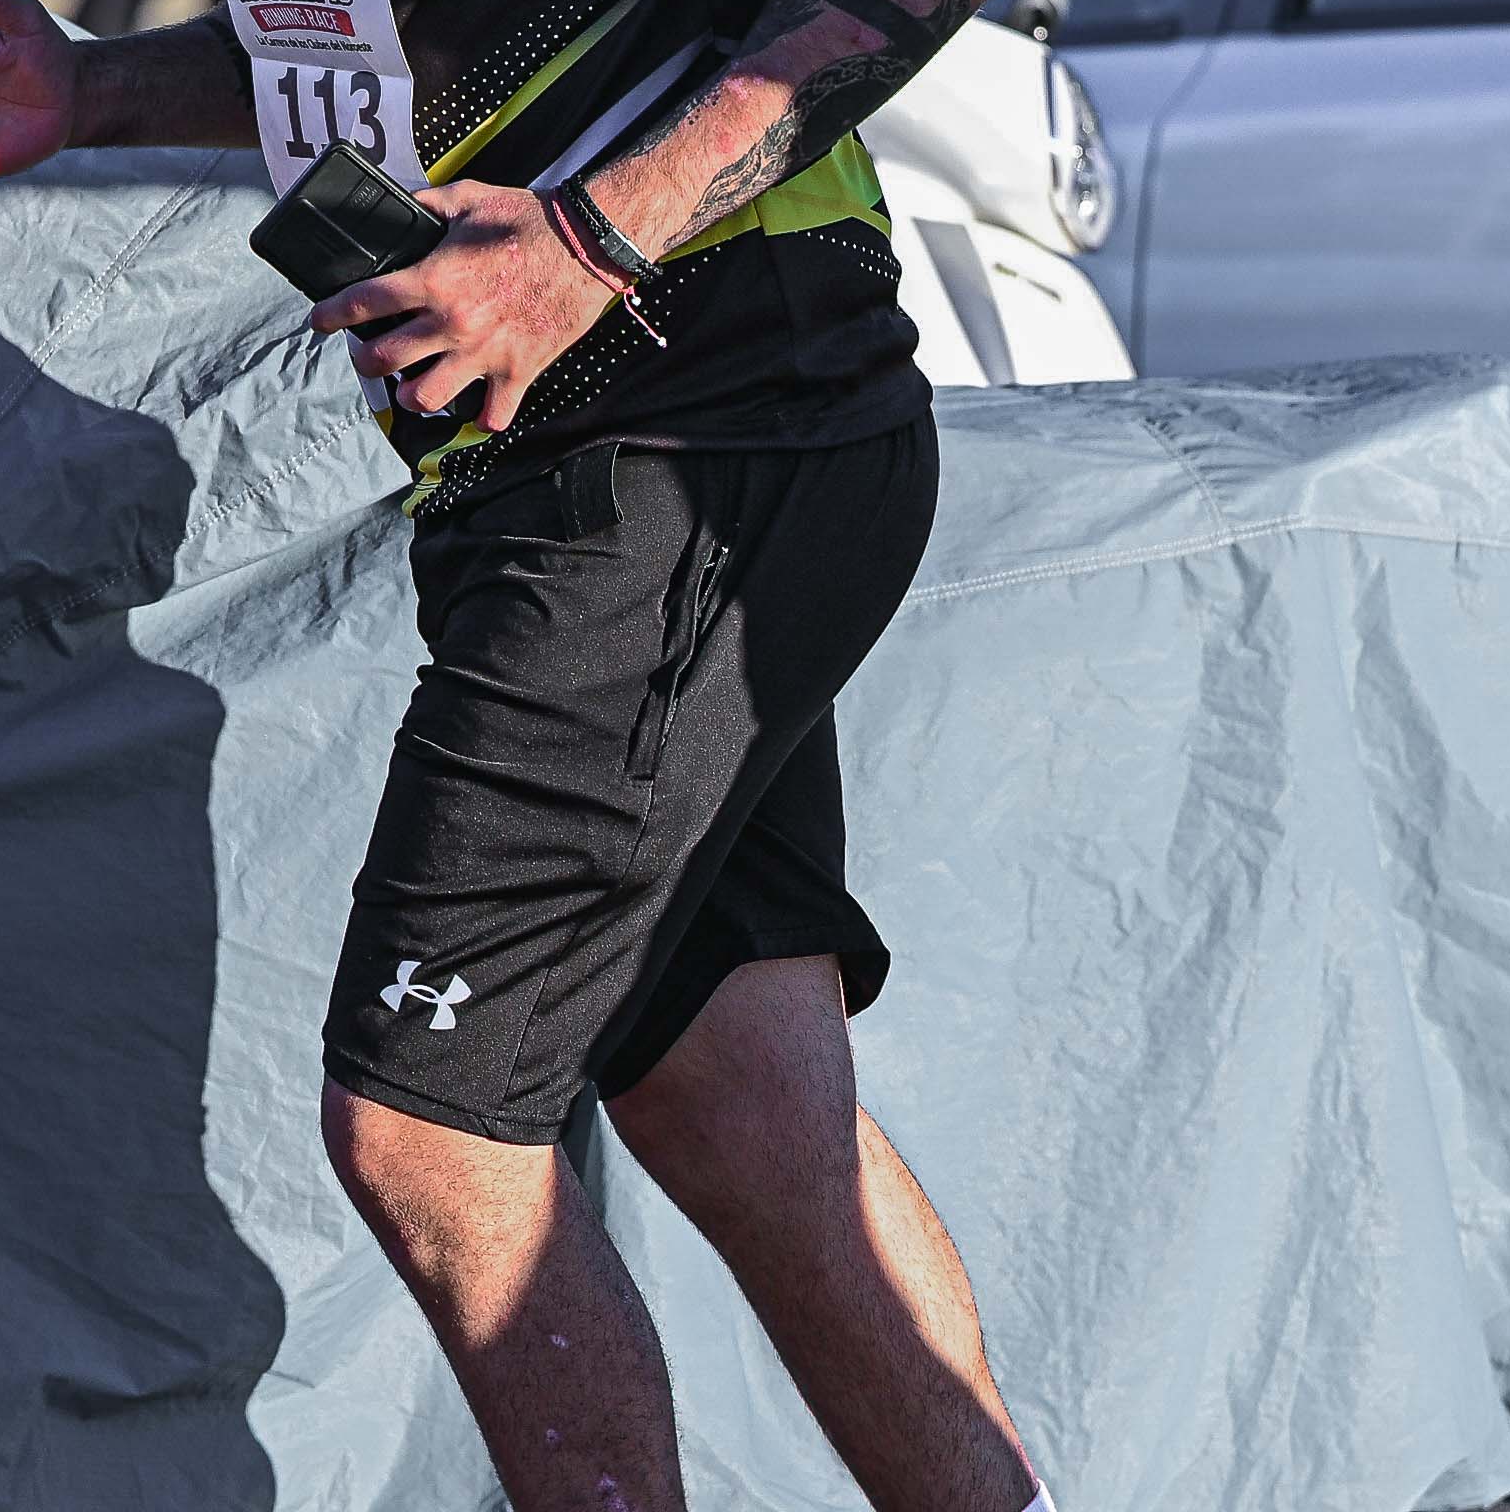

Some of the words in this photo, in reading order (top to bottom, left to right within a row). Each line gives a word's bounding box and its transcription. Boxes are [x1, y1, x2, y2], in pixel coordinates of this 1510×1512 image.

[259, 6, 307, 29] RUNNING
[306, 8, 341, 32] RACE
[277, 66, 387, 167] 113
